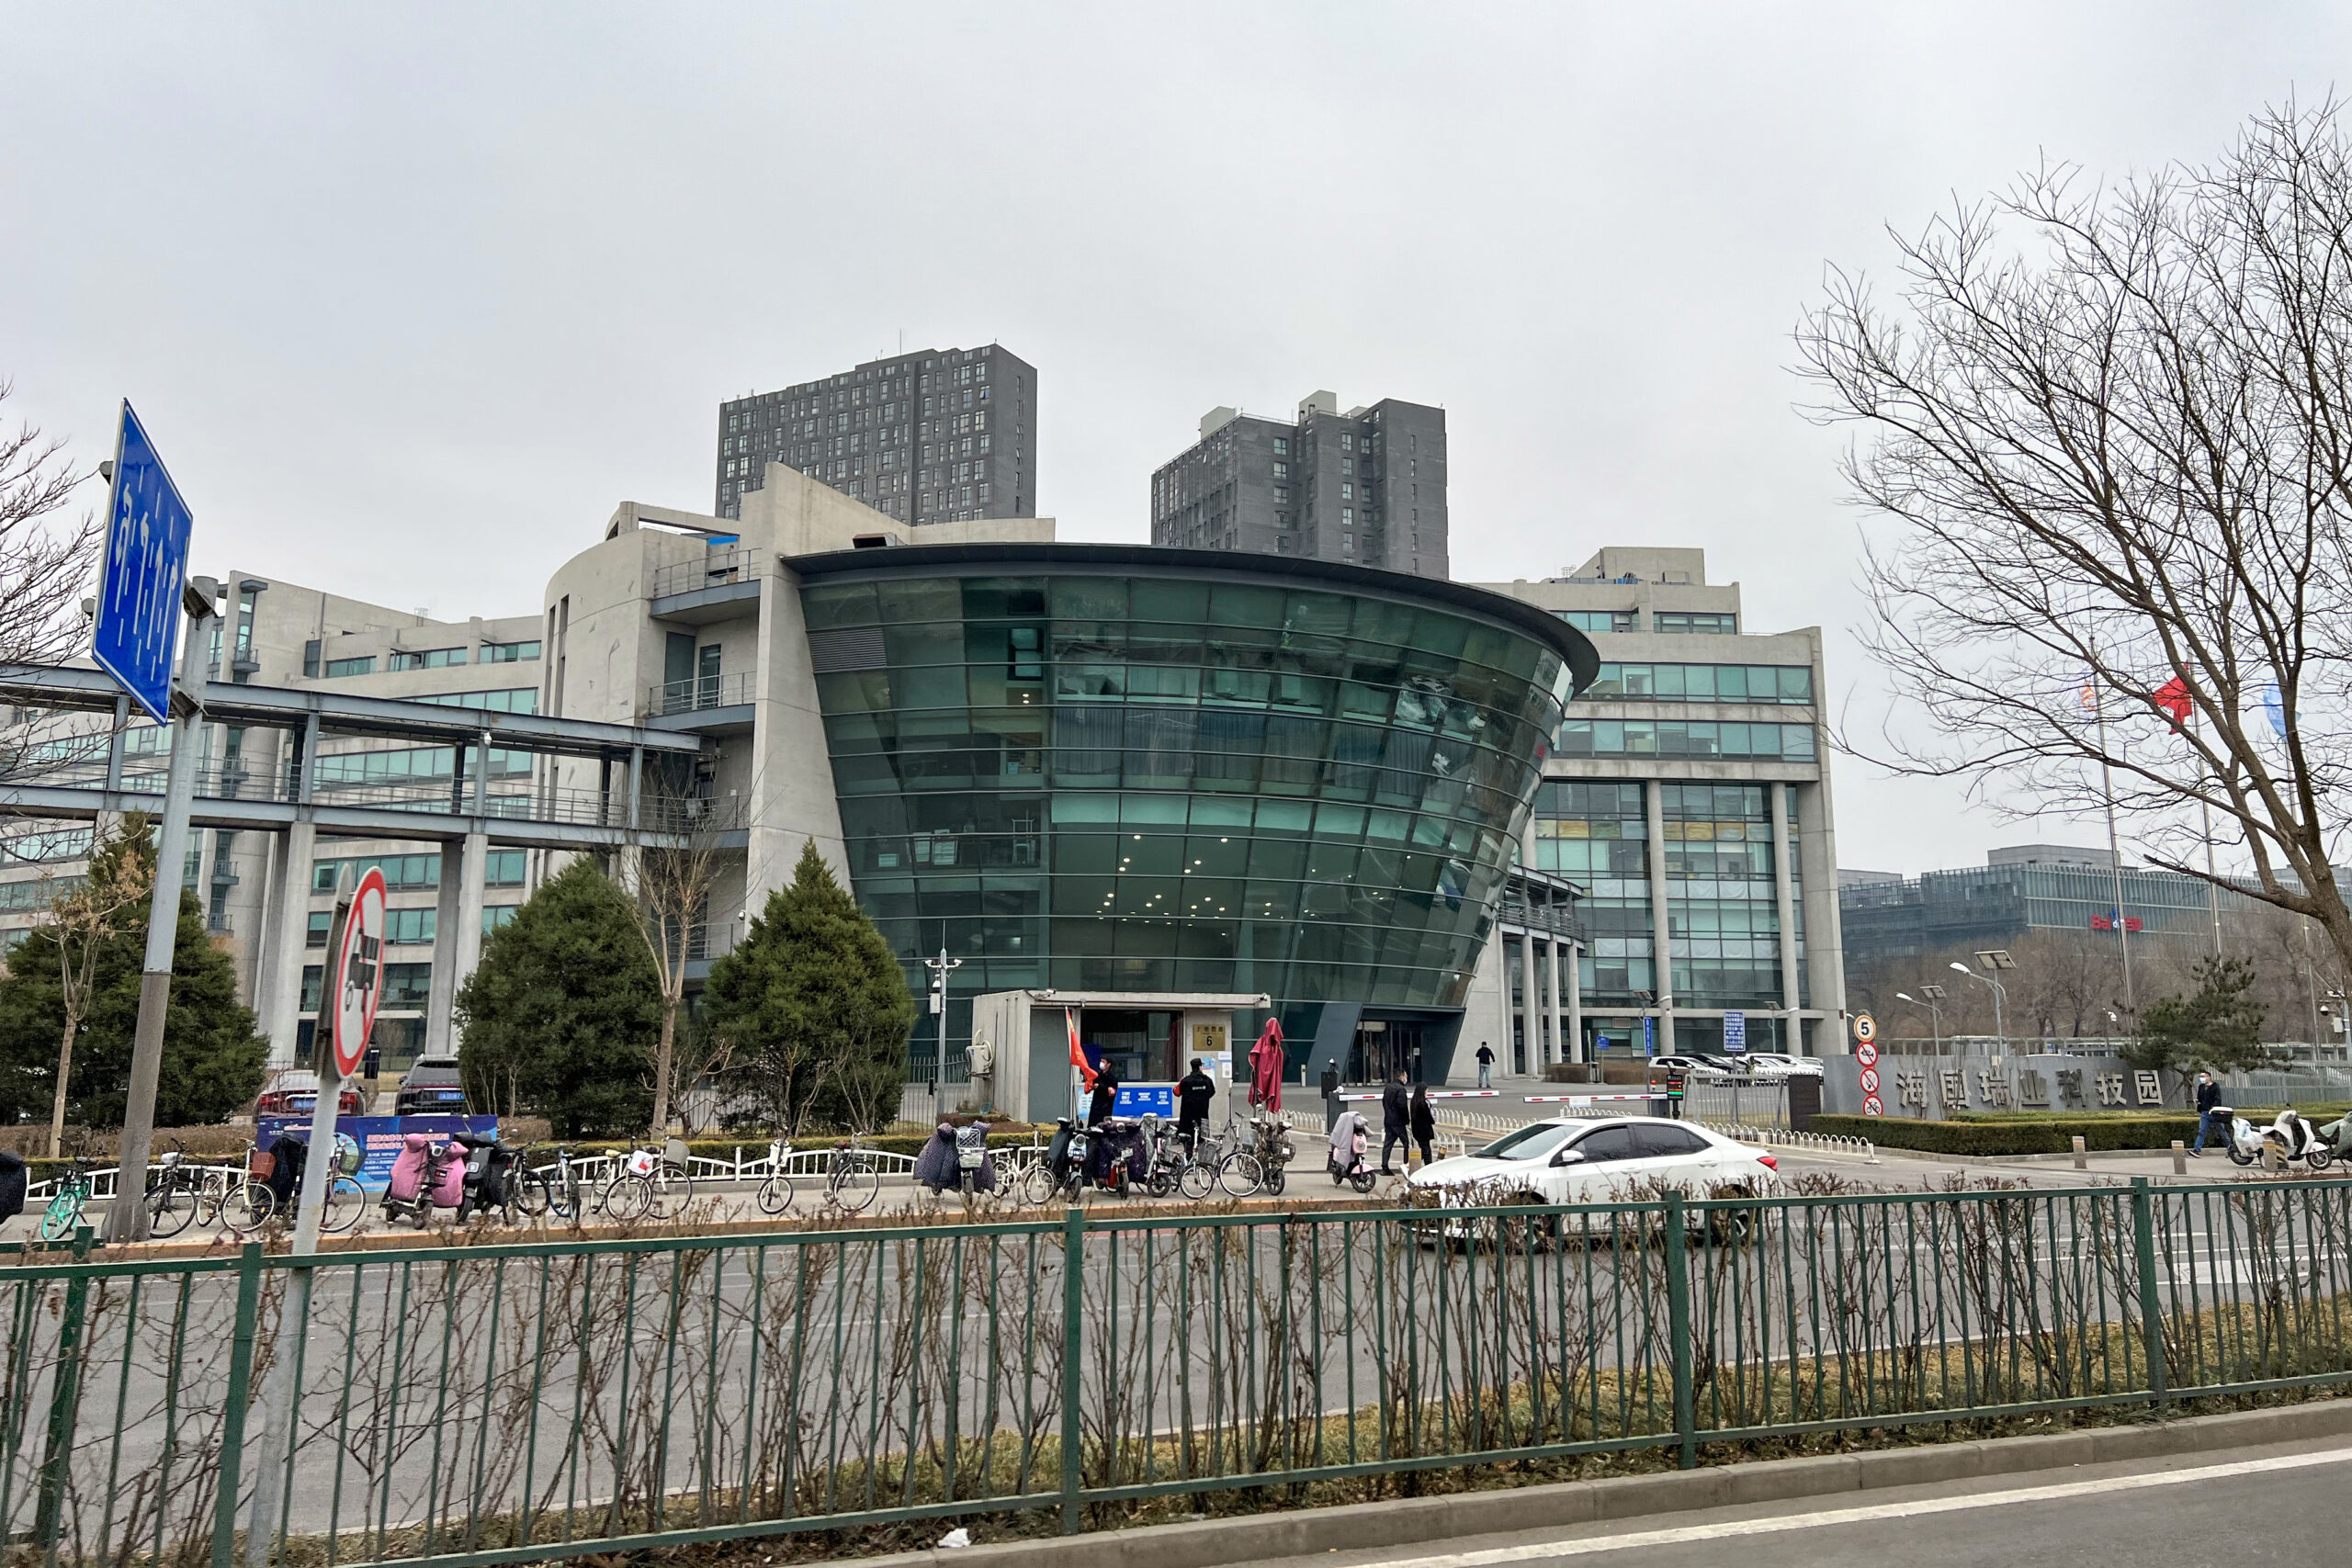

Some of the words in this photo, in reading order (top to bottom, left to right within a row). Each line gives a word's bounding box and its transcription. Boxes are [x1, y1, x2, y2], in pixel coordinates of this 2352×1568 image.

[1860, 1021, 1870, 1035] 5
[1206, 1035, 1213, 1046] 6
[1896, 1068, 2165, 1108] 海国瑞业科技园
